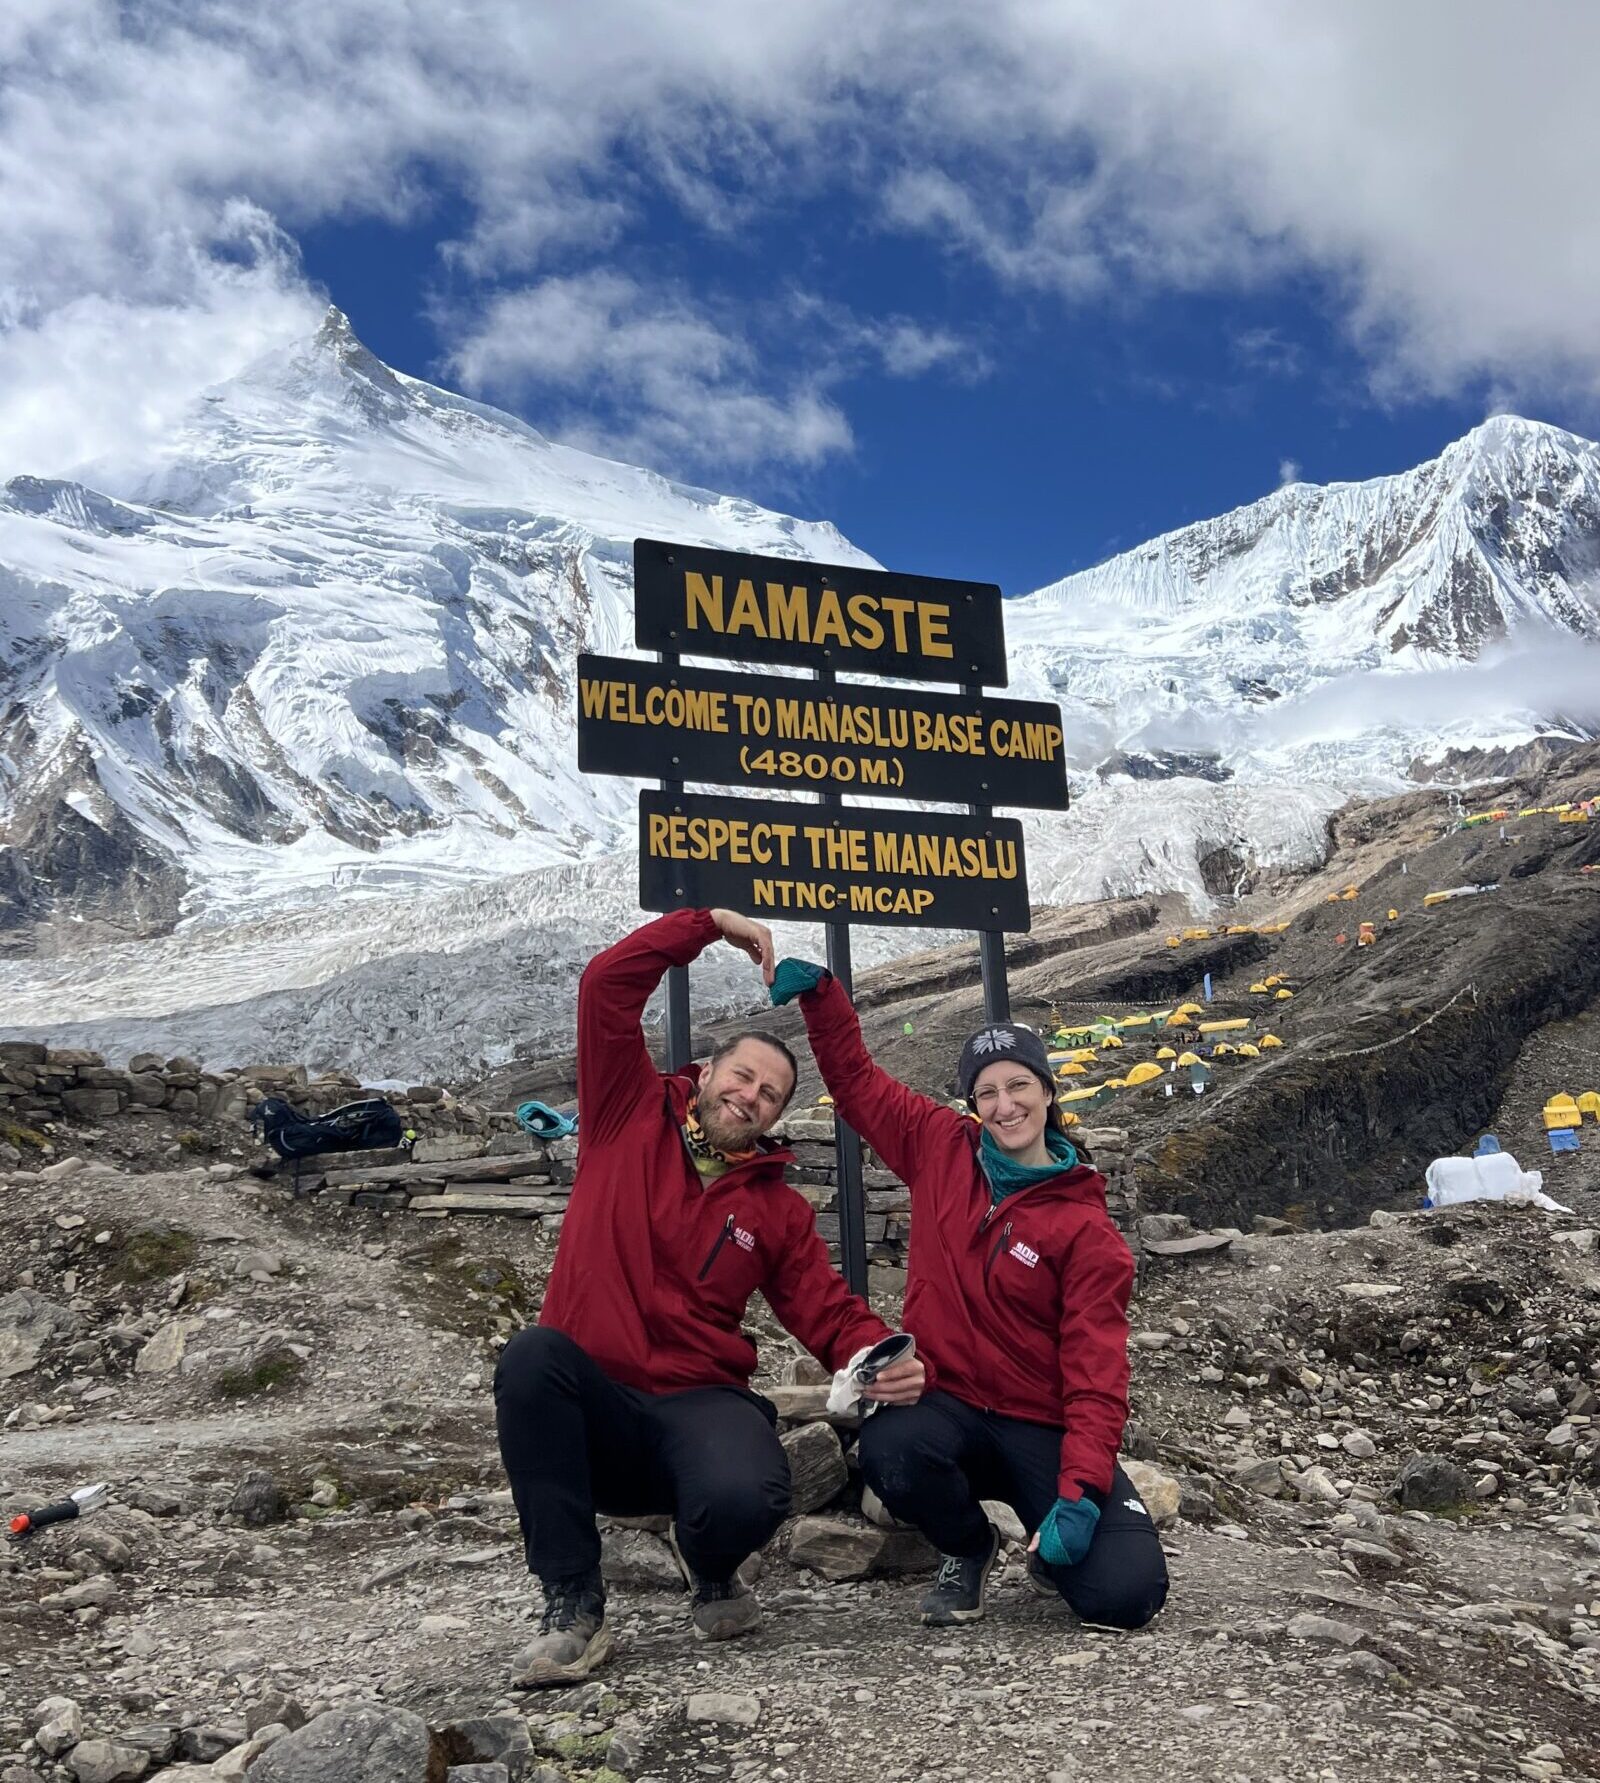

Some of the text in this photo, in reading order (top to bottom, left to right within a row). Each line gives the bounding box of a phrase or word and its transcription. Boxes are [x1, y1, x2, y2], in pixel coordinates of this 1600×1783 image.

[685, 571, 955, 660] NAMASTE
[580, 679, 1064, 761] WELCOME TO MANASLU BASE CAMP
[649, 813, 1018, 880] RESPECT THE MANASLU
[753, 879, 935, 915] NTNC-MCAP
